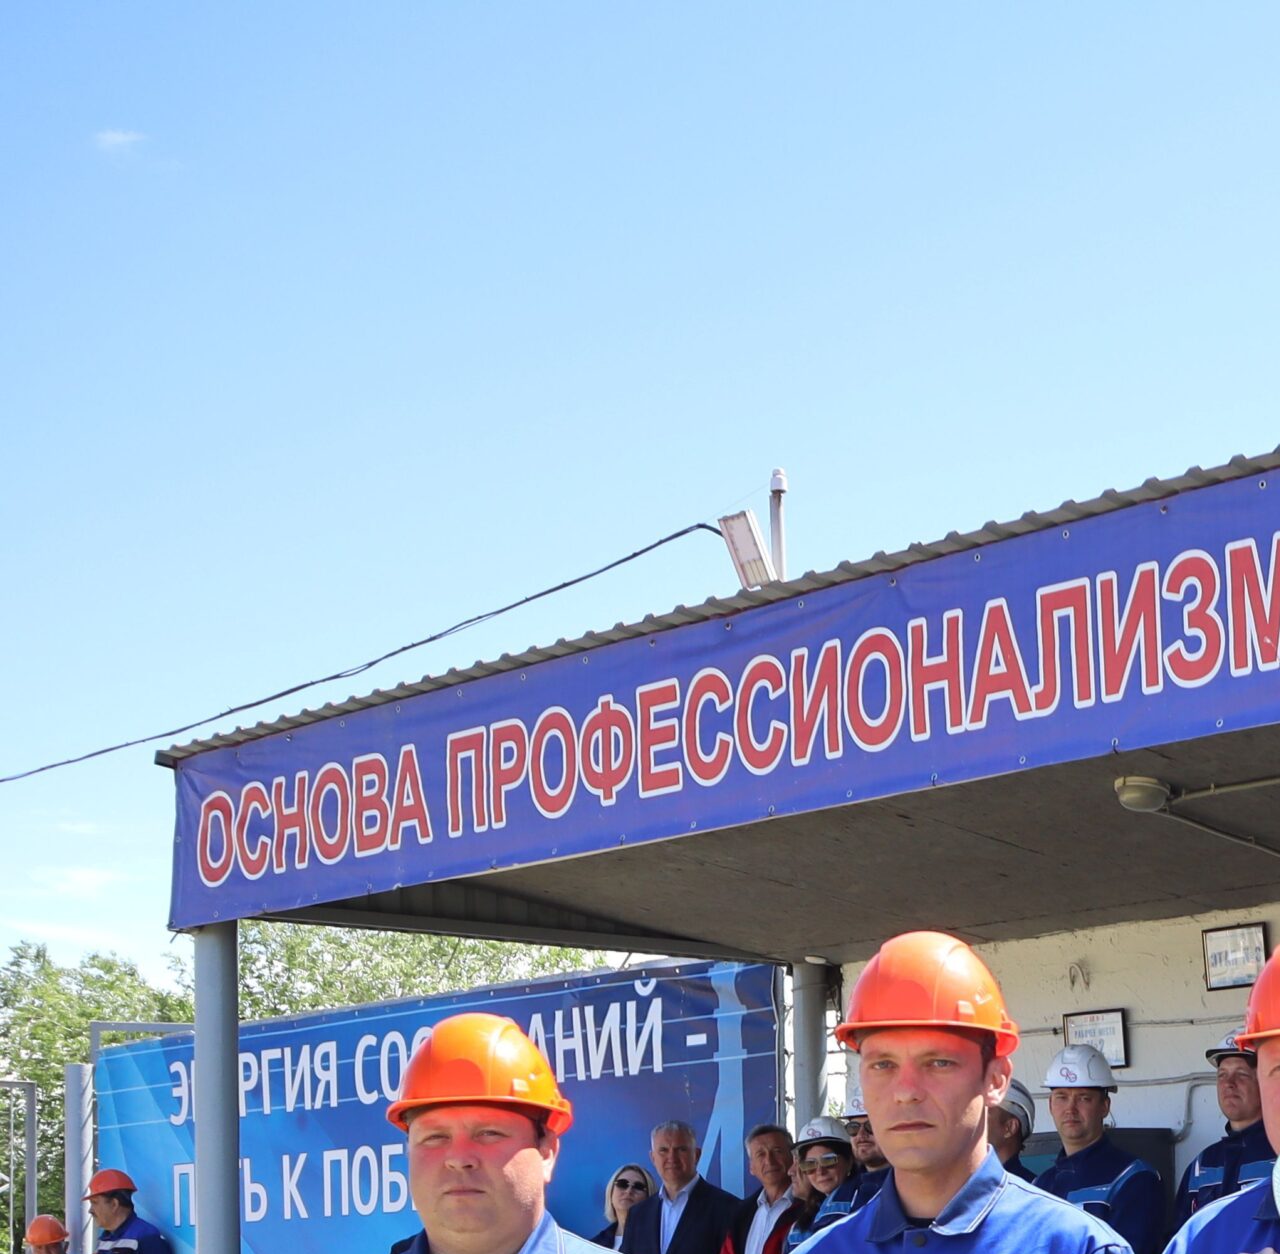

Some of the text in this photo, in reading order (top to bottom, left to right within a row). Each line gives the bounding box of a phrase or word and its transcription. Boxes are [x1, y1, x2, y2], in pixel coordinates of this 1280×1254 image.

[198, 743, 433, 887] ОСНОВА
[170, 1041, 339, 1126] ЭРГИЯ
[173, 1144, 418, 1227] ПЬ К ПОБ
